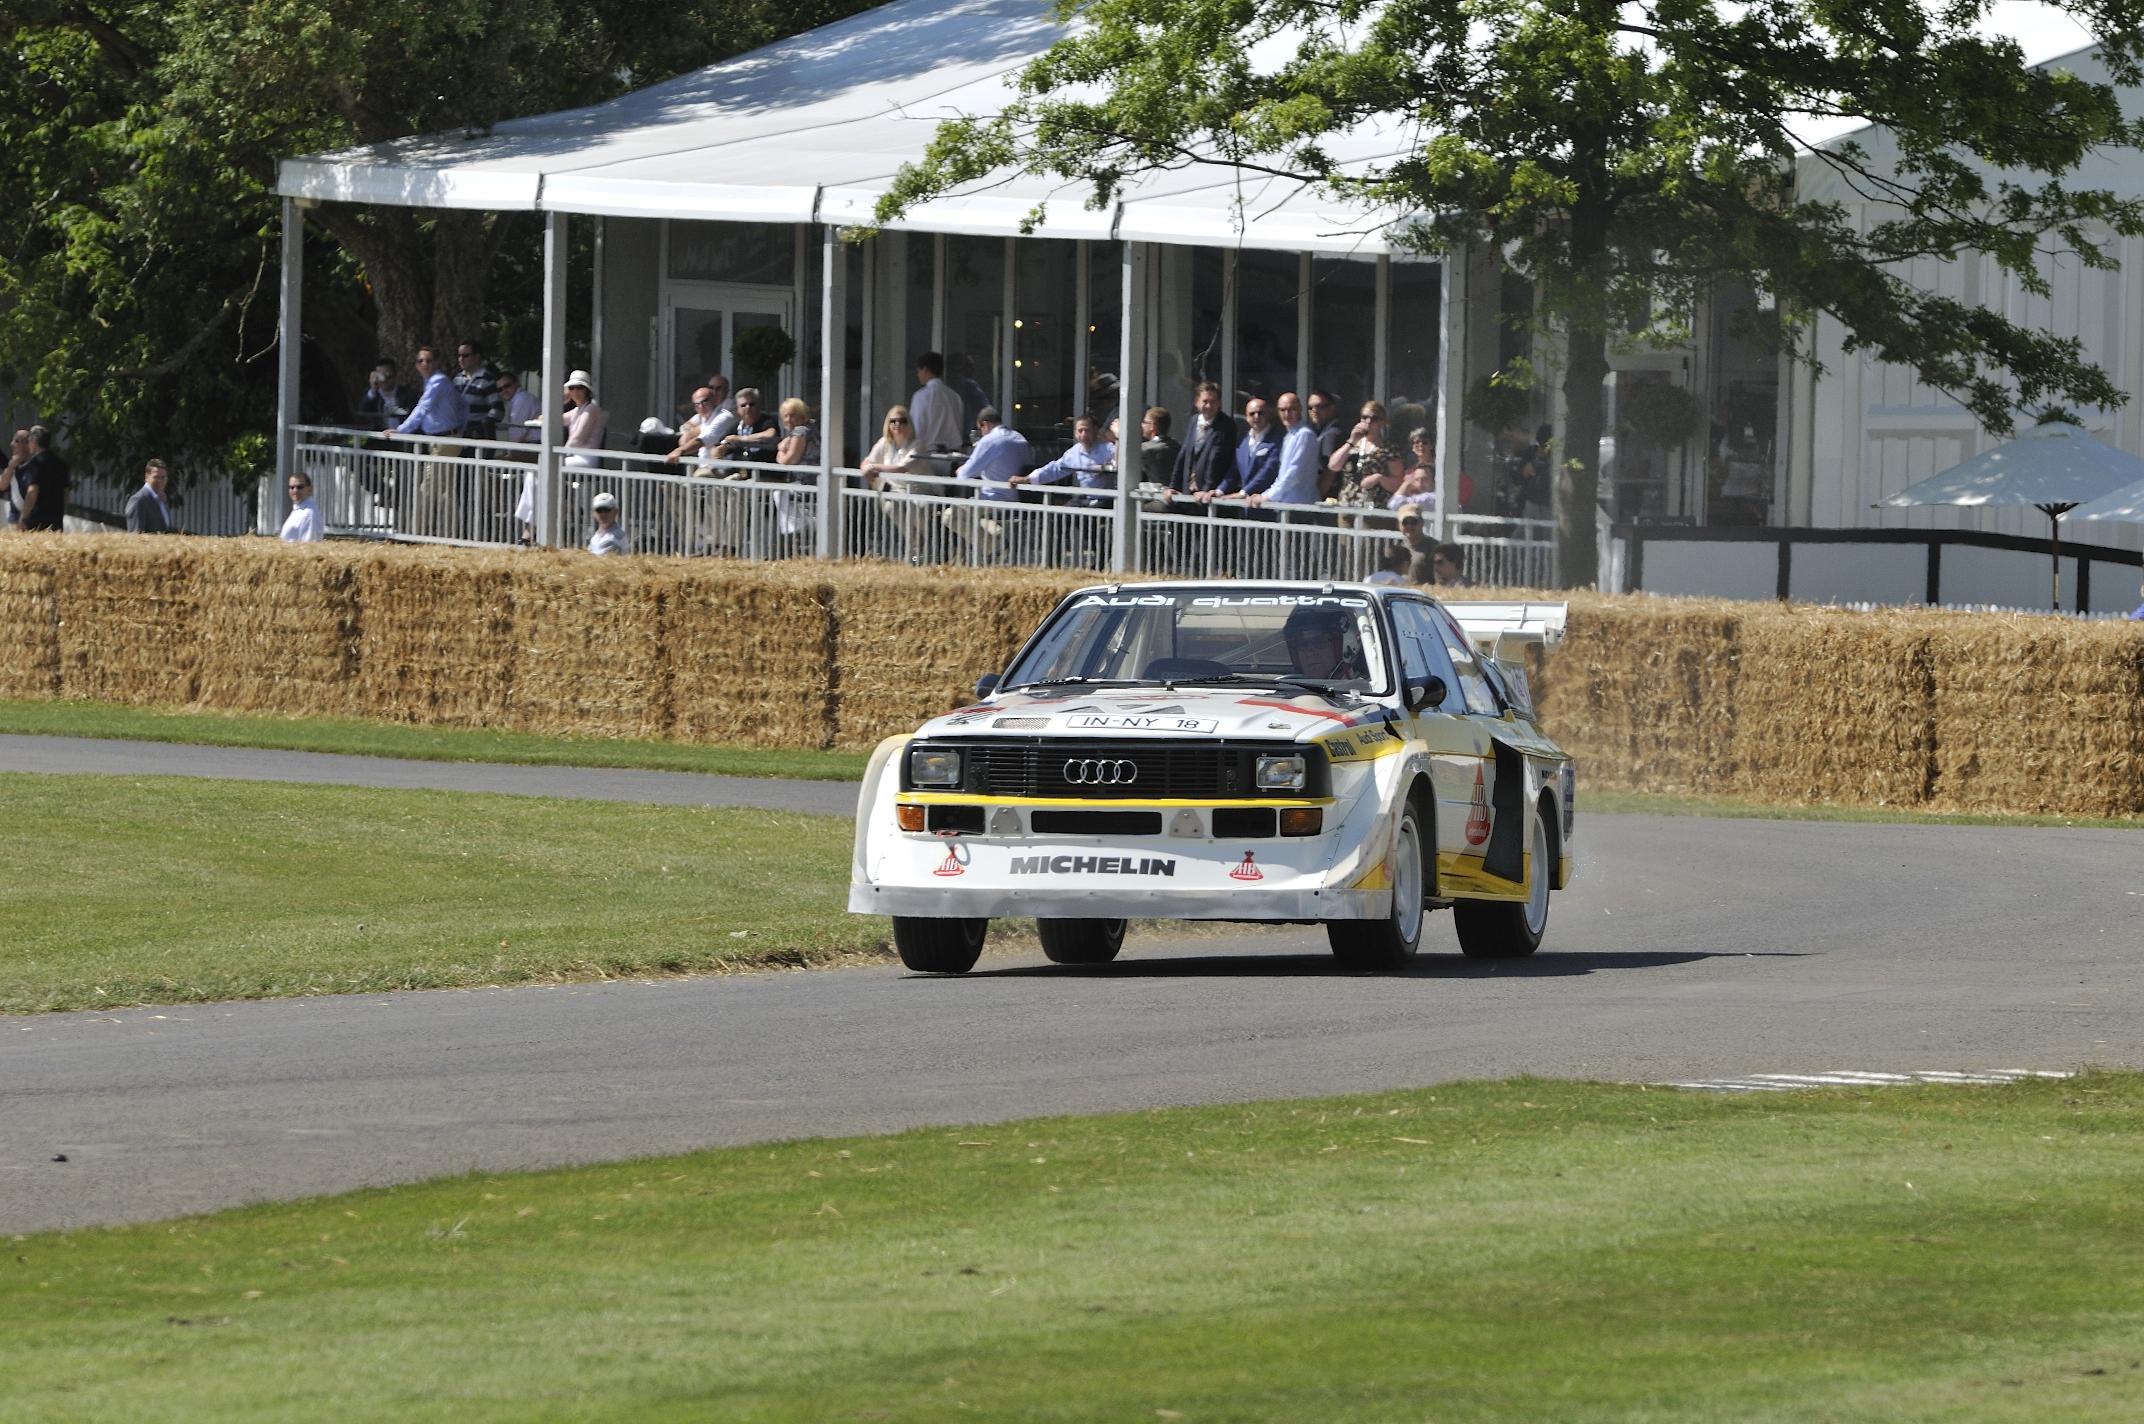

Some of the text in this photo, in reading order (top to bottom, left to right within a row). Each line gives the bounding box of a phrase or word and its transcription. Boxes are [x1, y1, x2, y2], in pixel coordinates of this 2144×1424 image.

[1071, 595, 1368, 609] Audi quattro
[1082, 716, 1199, 730] IN-NY 18
[1009, 855, 1176, 877] MICHELIN
[1238, 862, 1257, 875] HB
